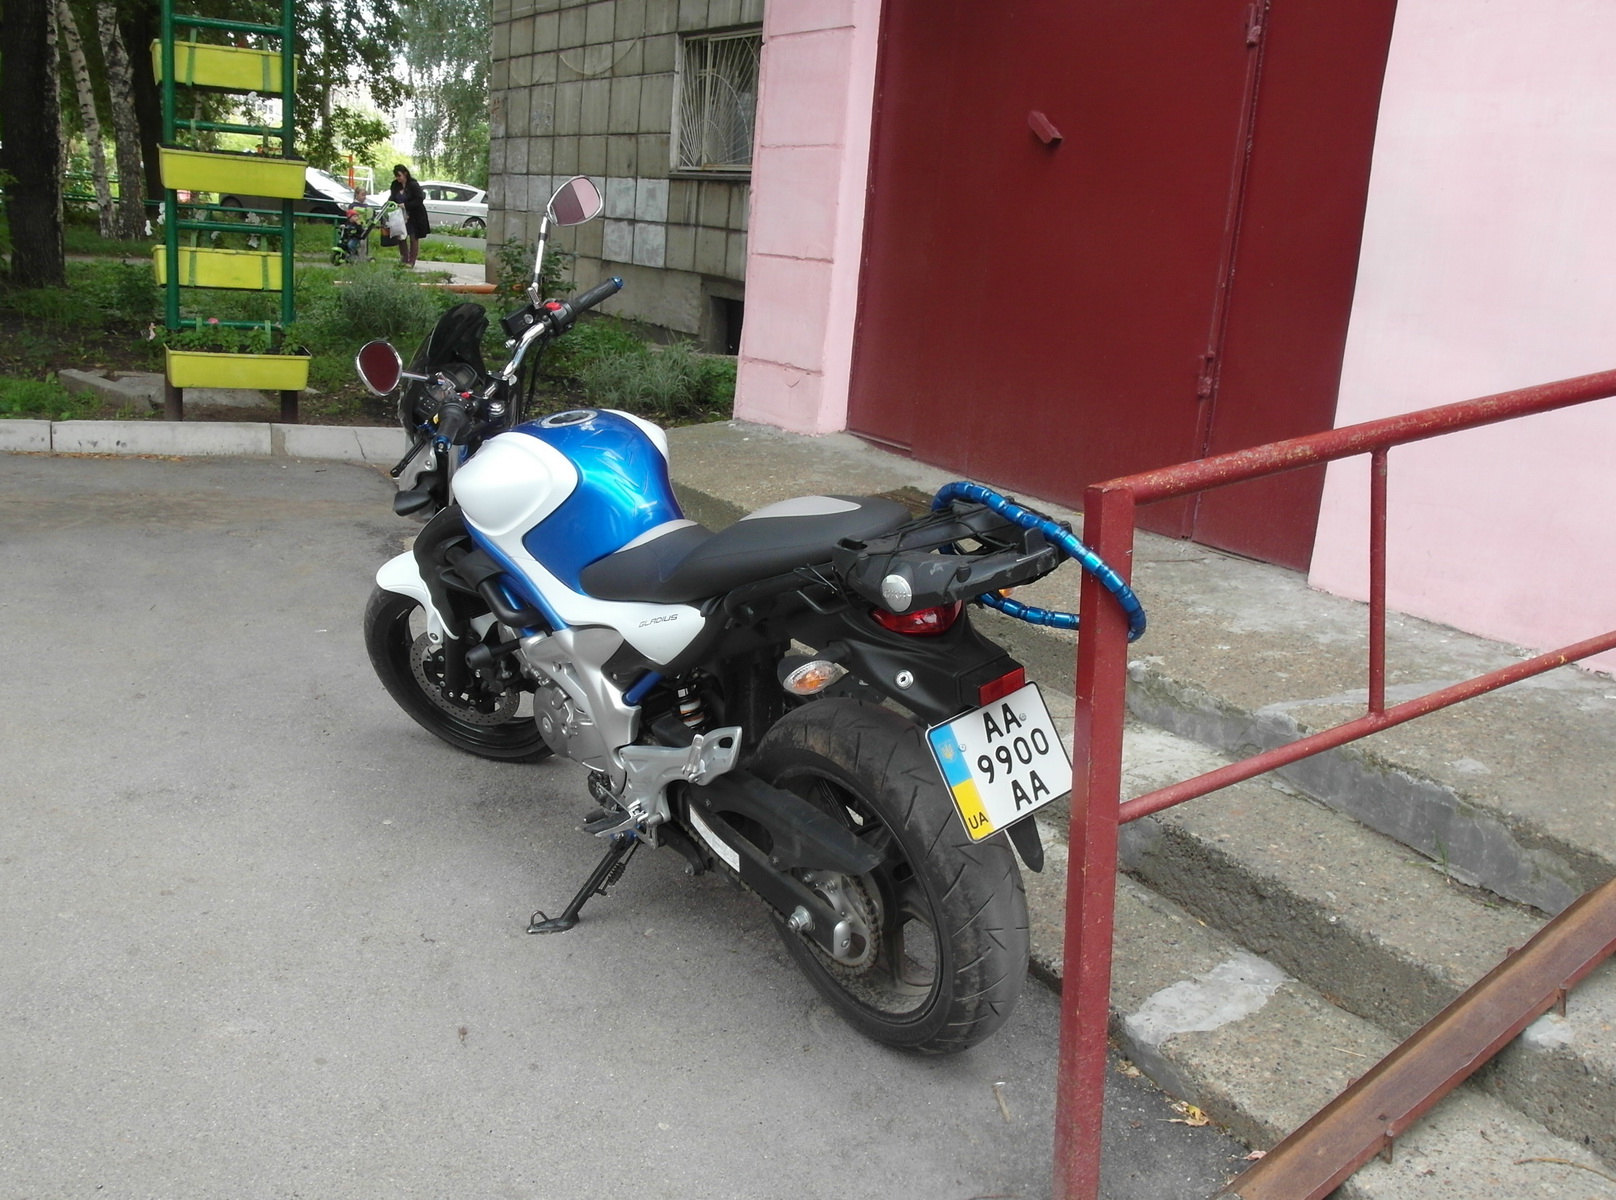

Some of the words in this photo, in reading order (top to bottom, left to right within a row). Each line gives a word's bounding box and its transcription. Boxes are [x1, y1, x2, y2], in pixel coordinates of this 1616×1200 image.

[638, 613, 679, 628] GLADIUS
[982, 702, 1022, 743] AA
[977, 728, 1049, 784] 9900
[1011, 770, 1050, 811] AA
[968, 811, 989, 829] UA
